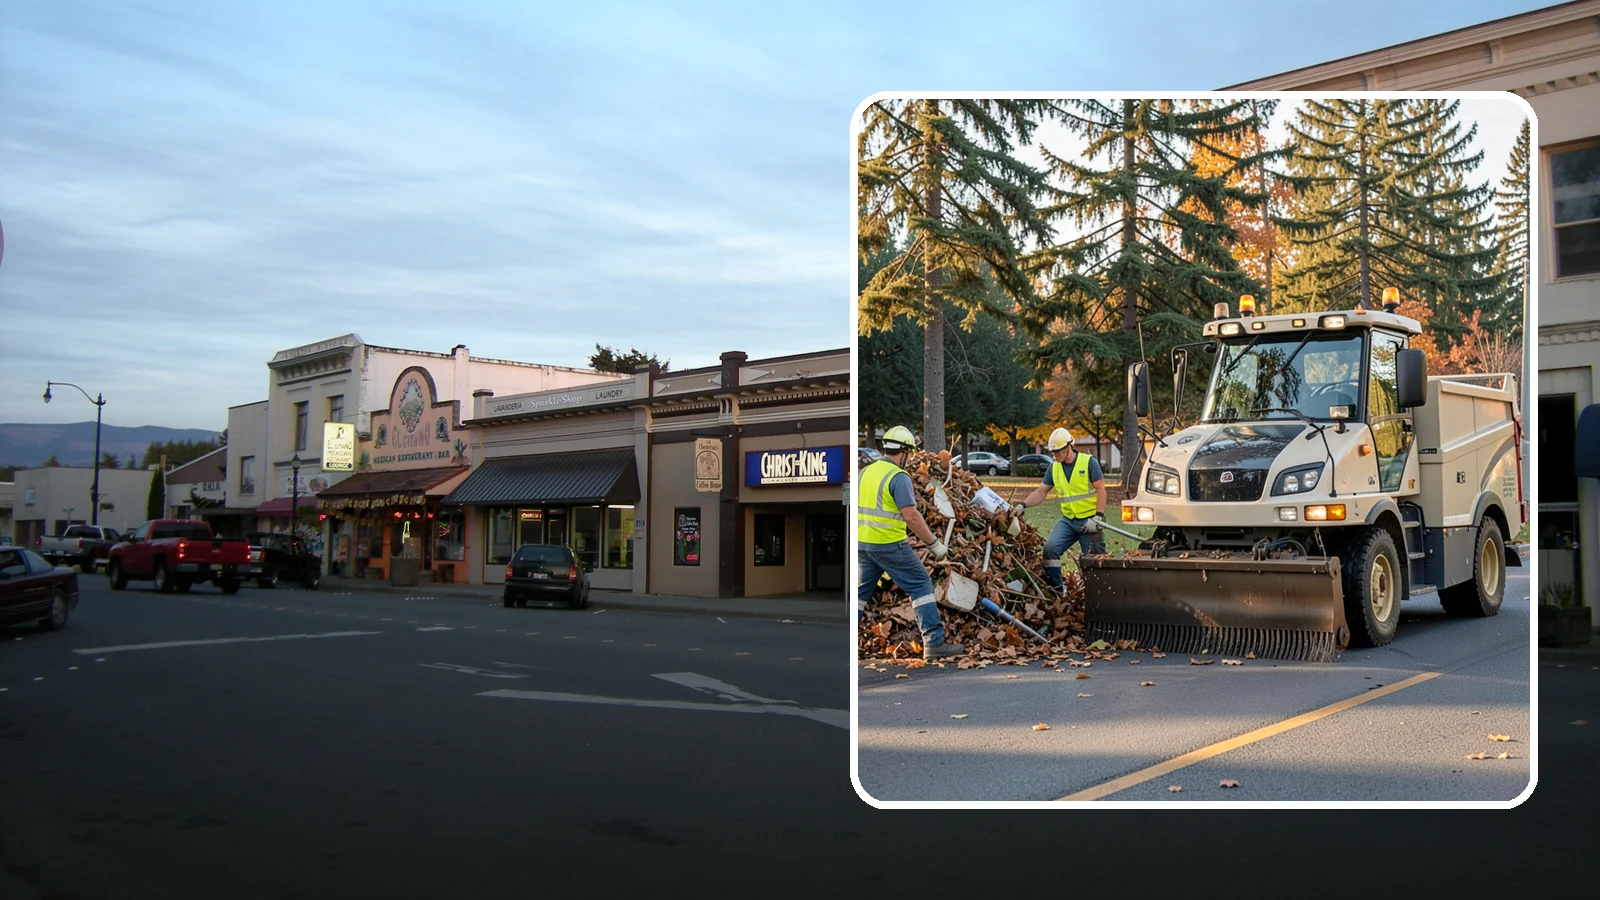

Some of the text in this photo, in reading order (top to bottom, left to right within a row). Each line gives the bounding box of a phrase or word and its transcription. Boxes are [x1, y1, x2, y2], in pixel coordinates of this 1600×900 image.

[531, 394, 582, 409] Sparkle Shop
[595, 389, 623, 400] LAUNDRY
[493, 402, 522, 413] LAVANDERIA
[392, 425, 400, 449] EL
[374, 455, 396, 464] MEXICAN
[397, 451, 433, 462] RESTAURANT
[437, 450, 450, 459] BAR
[799, 450, 827, 476] KING
